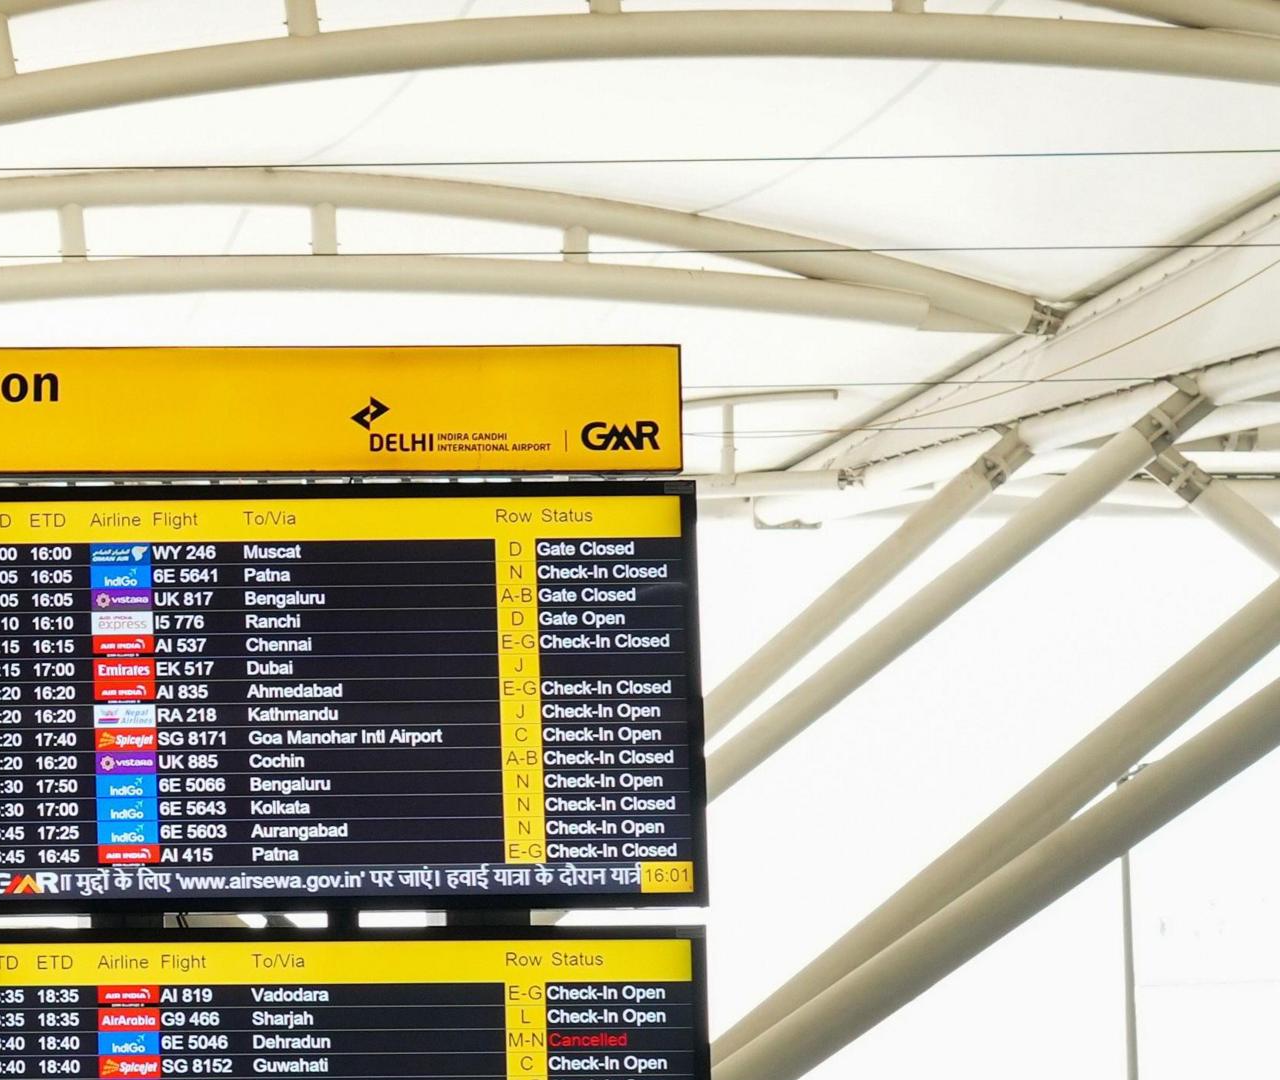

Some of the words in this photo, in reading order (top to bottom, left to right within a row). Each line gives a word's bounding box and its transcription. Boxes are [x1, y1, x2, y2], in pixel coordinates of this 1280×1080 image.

[370, 434, 433, 451] DELHI
[438, 432, 470, 442] INDIRA
[471, 432, 506, 442] GANDHI
[582, 420, 659, 451] GMR
[438, 443, 508, 451] INTERNATIONAL
[512, 443, 550, 451] AIRPORT
[30, 513, 65, 527] ETD
[90, 513, 140, 526] Airline
[154, 512, 197, 529] Flight
[243, 510, 296, 526] To/Via
[495, 508, 532, 524] Row
[542, 508, 592, 523] Status
[34, 663, 74, 676] 17:00
[98, 664, 150, 676] Emirates
[156, 659, 179, 676] EK
[185, 661, 214, 675] 517
[247, 661, 293, 675] Dubai
[515, 658, 522, 673] J
[38, 1013, 79, 1026] 18:35
[102, 1016, 155, 1025] AirArabia
[161, 1012, 185, 1026] G9
[189, 1012, 219, 1025] 466
[252, 1011, 313, 1028] Sharjah
[521, 1008, 530, 1024] L
[547, 1009, 618, 1023] Check-In
[623, 1009, 666, 1026] Open
[549, 1030, 630, 1046] Cancelled
